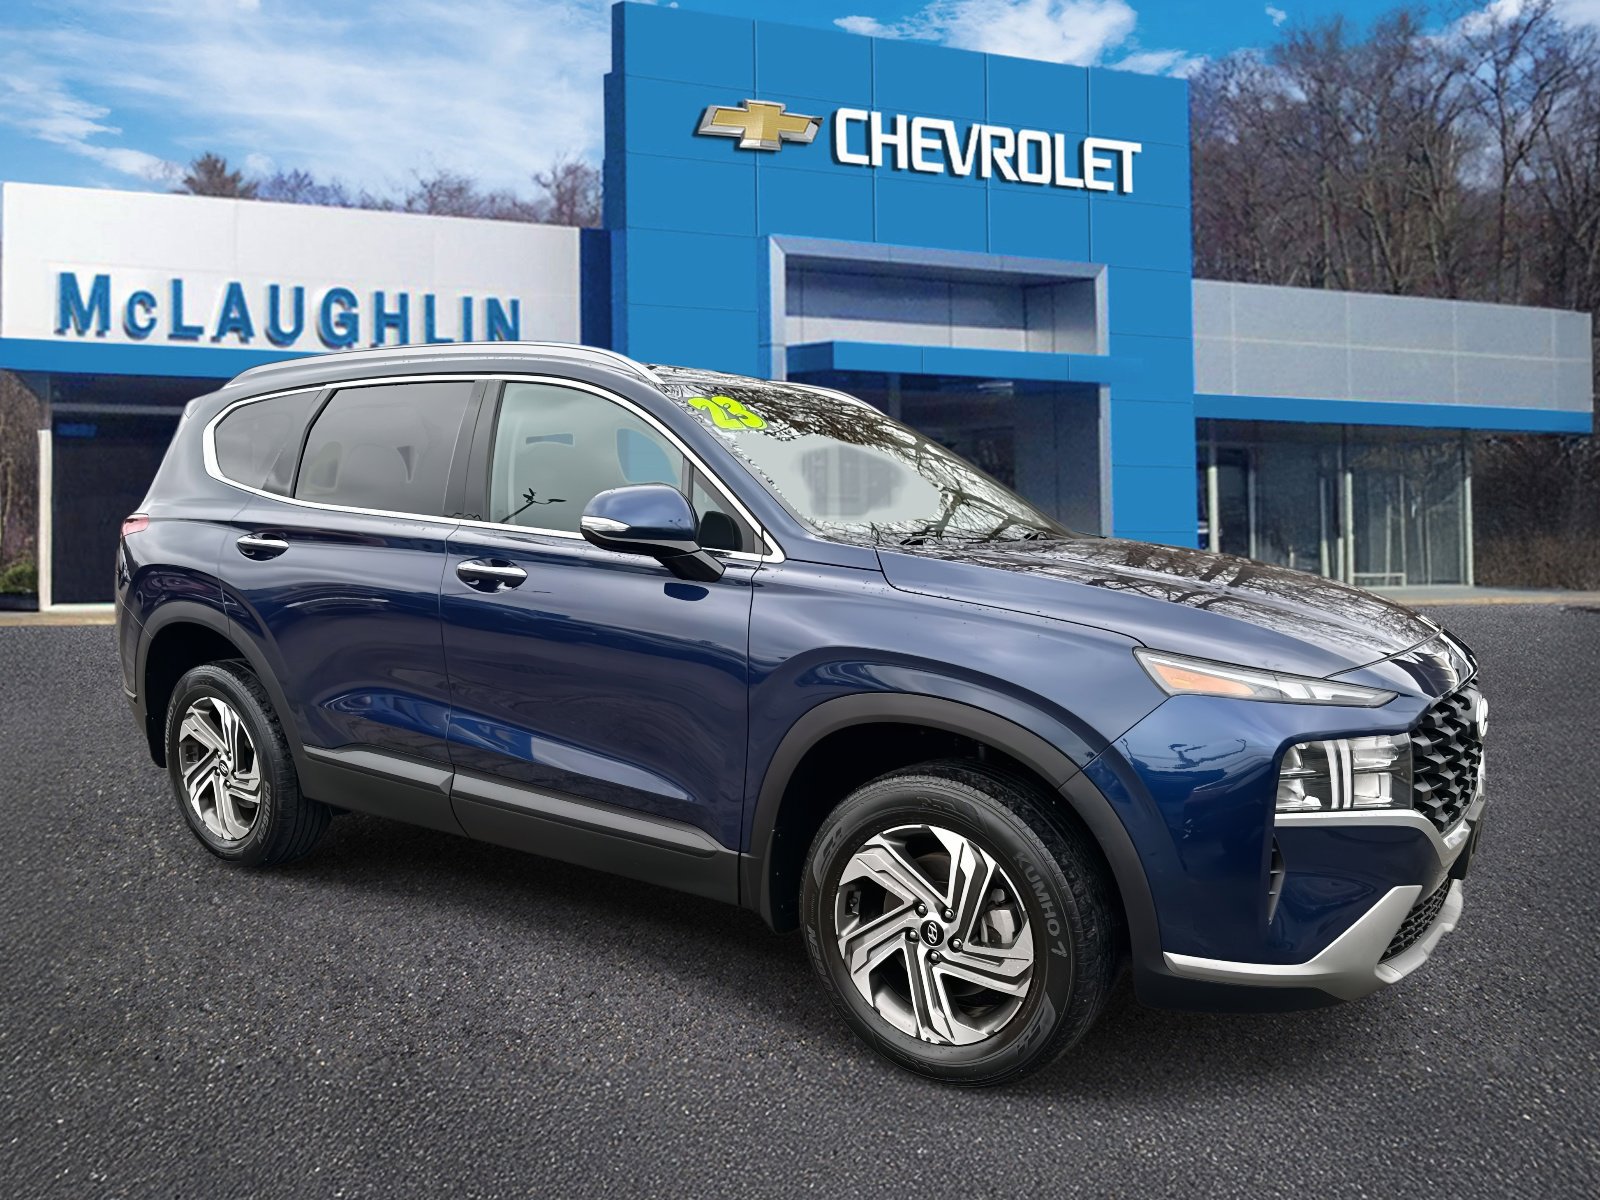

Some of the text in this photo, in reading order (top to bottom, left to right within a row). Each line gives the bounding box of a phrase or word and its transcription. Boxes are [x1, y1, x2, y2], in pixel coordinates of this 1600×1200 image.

[834, 107, 1142, 194] CHEVROLET
[56, 271, 522, 347] McLAUGHLIN
[687, 395, 768, 430] 23
[1013, 852, 1061, 937] KUMHO
